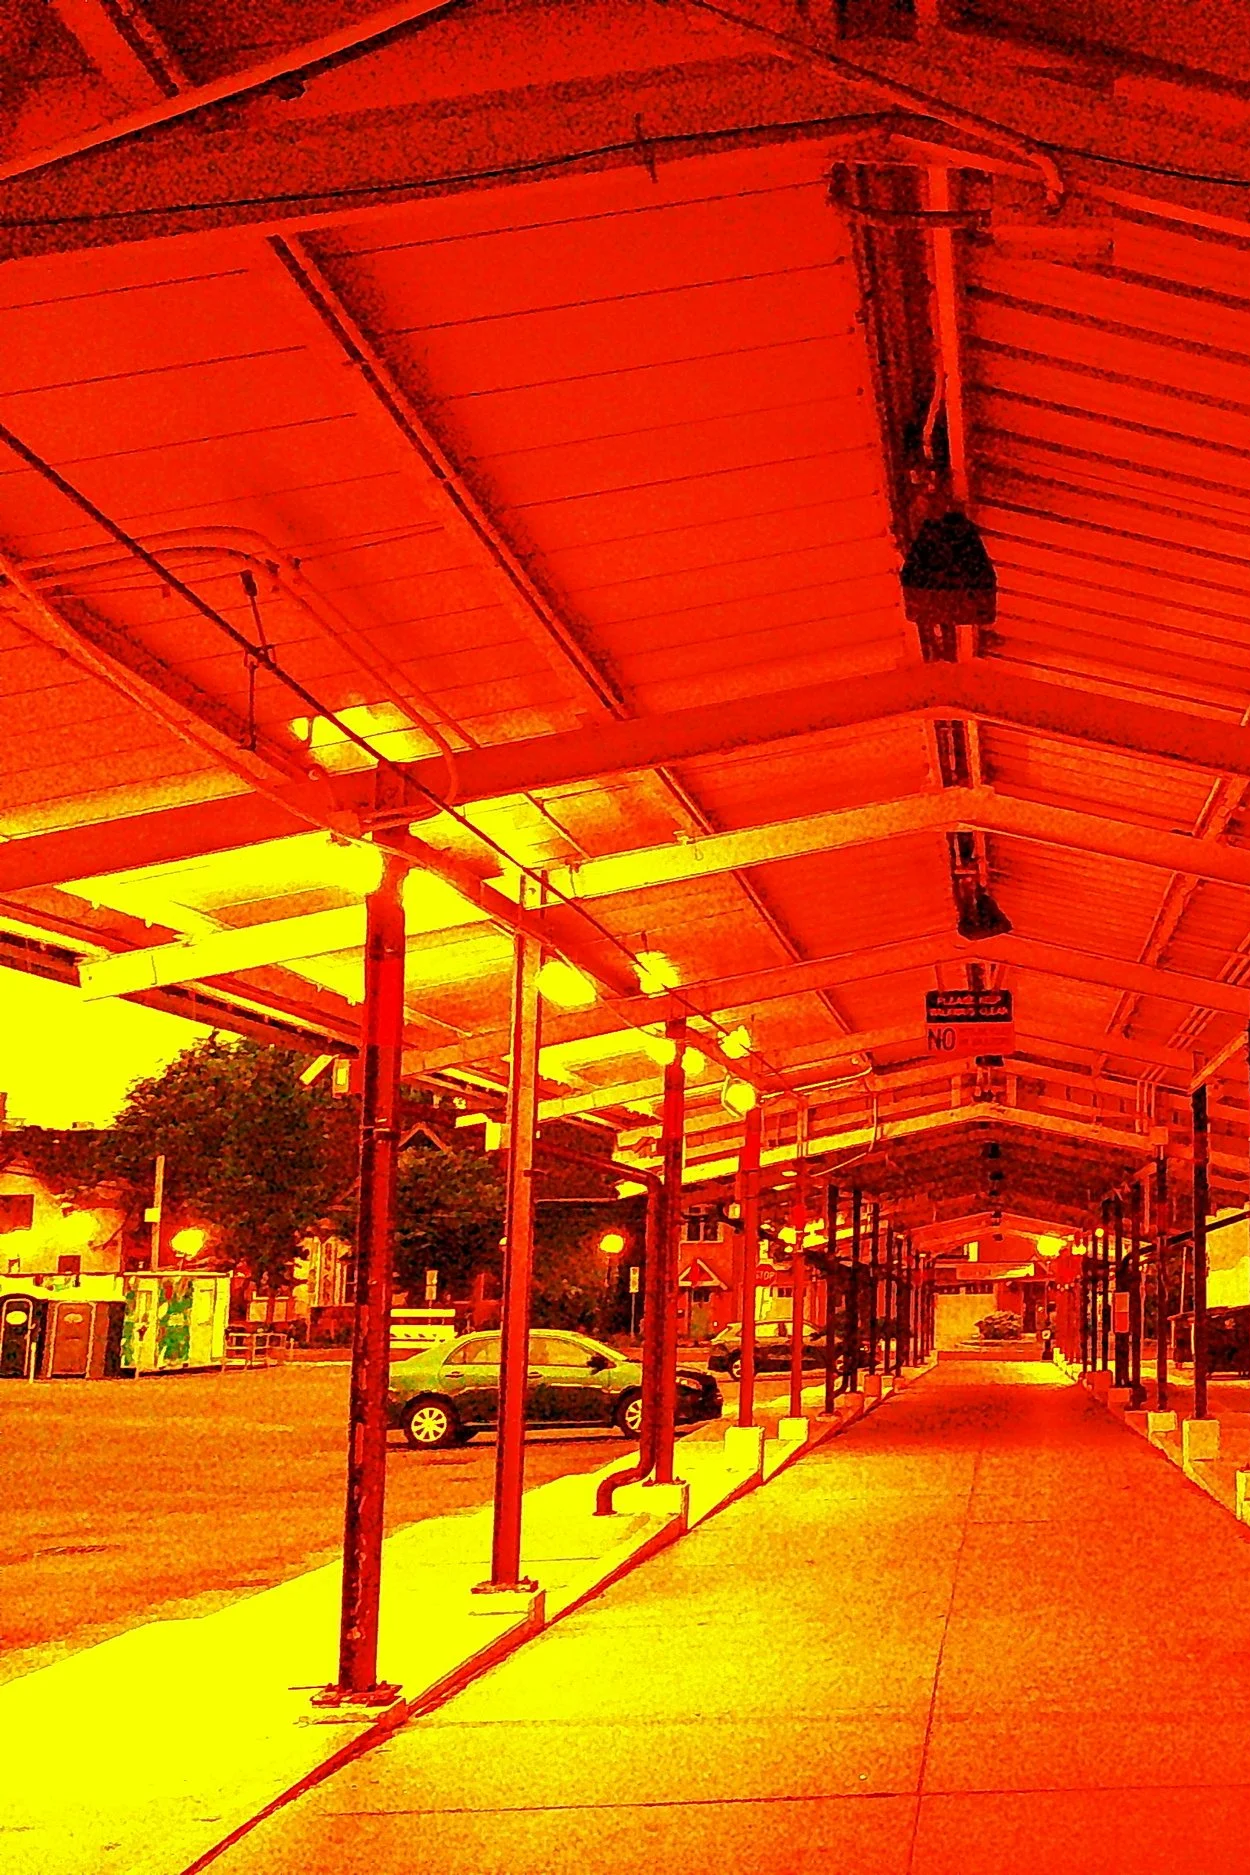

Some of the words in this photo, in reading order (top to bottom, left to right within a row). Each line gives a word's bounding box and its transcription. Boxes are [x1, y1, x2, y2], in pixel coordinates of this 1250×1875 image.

[936, 995, 976, 1005] PLEASE
[979, 1006, 1009, 1017] CLEAR
[927, 1027, 956, 1051] NO
